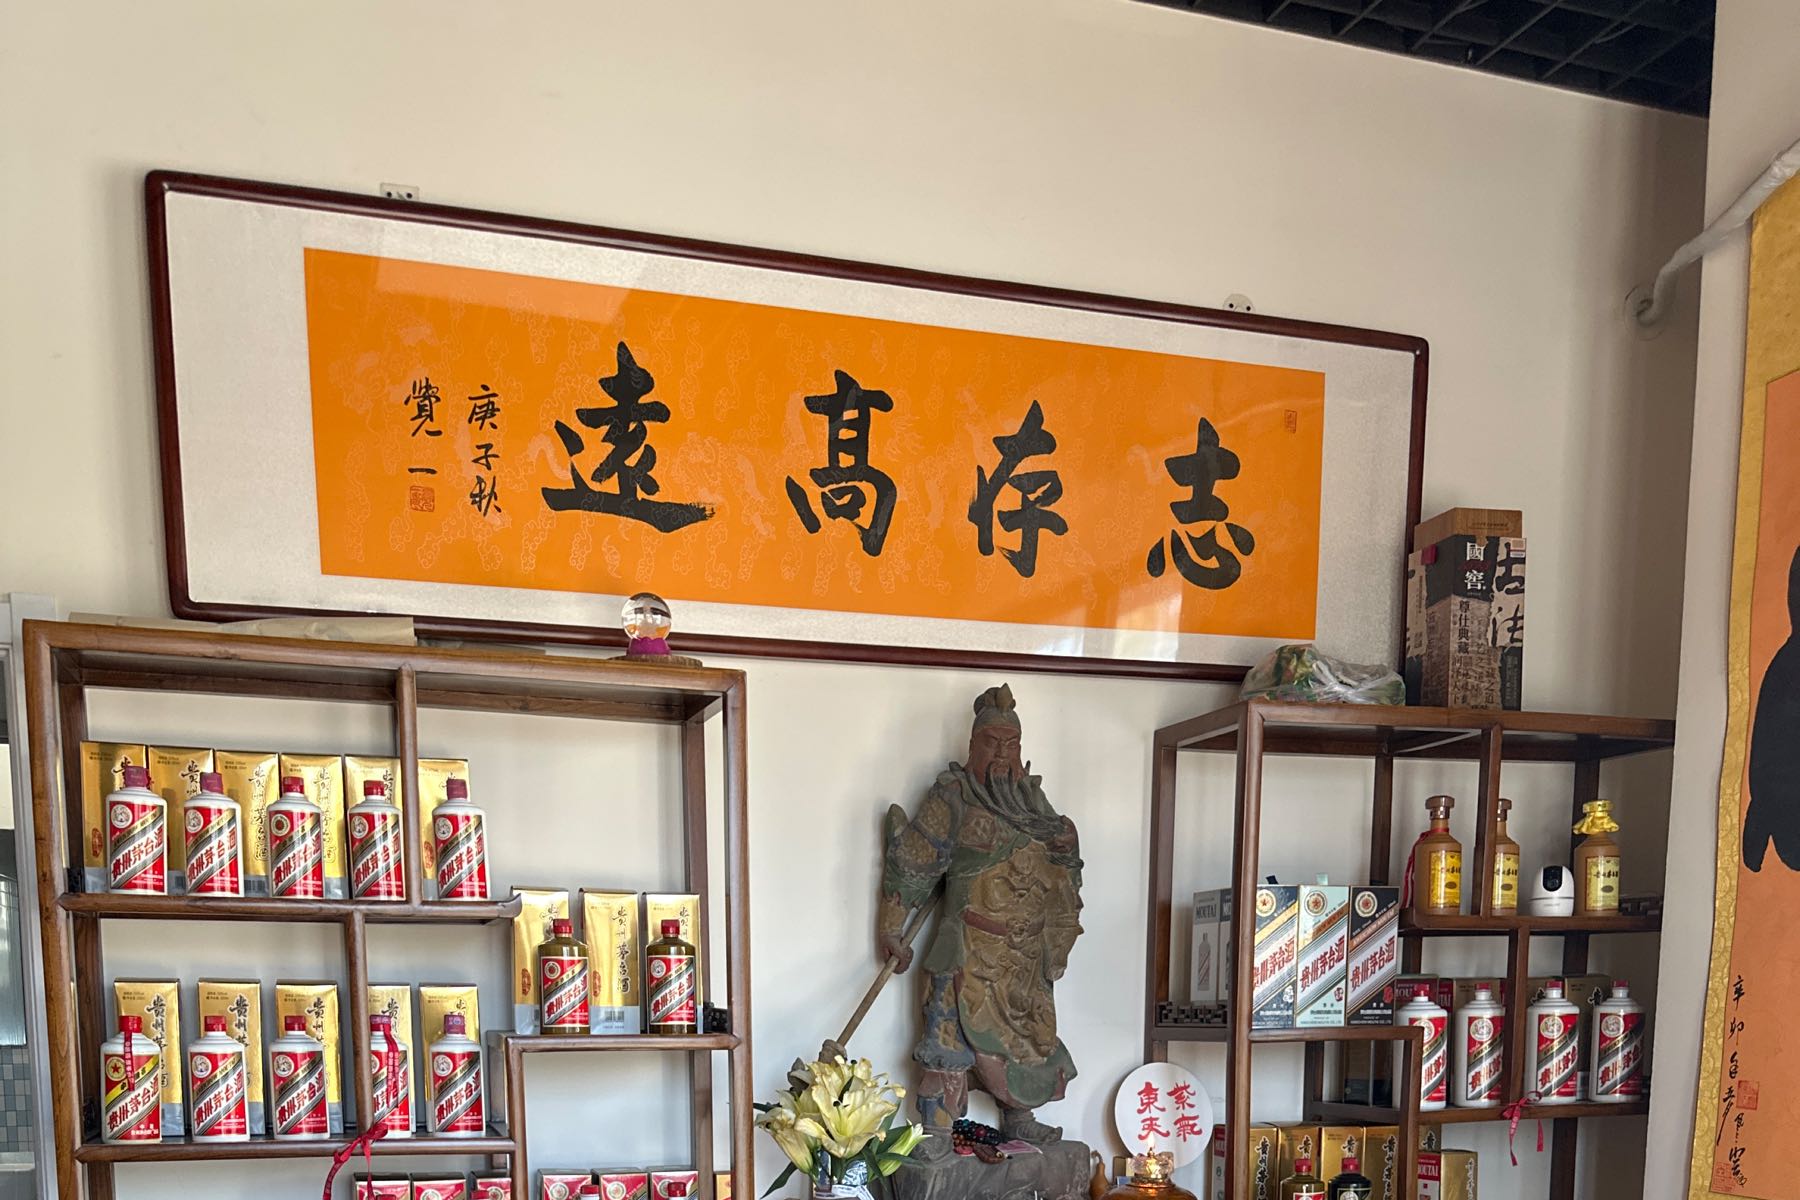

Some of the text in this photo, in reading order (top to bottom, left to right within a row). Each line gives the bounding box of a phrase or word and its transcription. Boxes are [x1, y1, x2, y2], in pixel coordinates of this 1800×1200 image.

[1300, 934, 1345, 992] 贵州茅台酒
[1351, 934, 1395, 992] 贵州茅台酒
[107, 1073, 159, 1132] 贵州茅台酒
